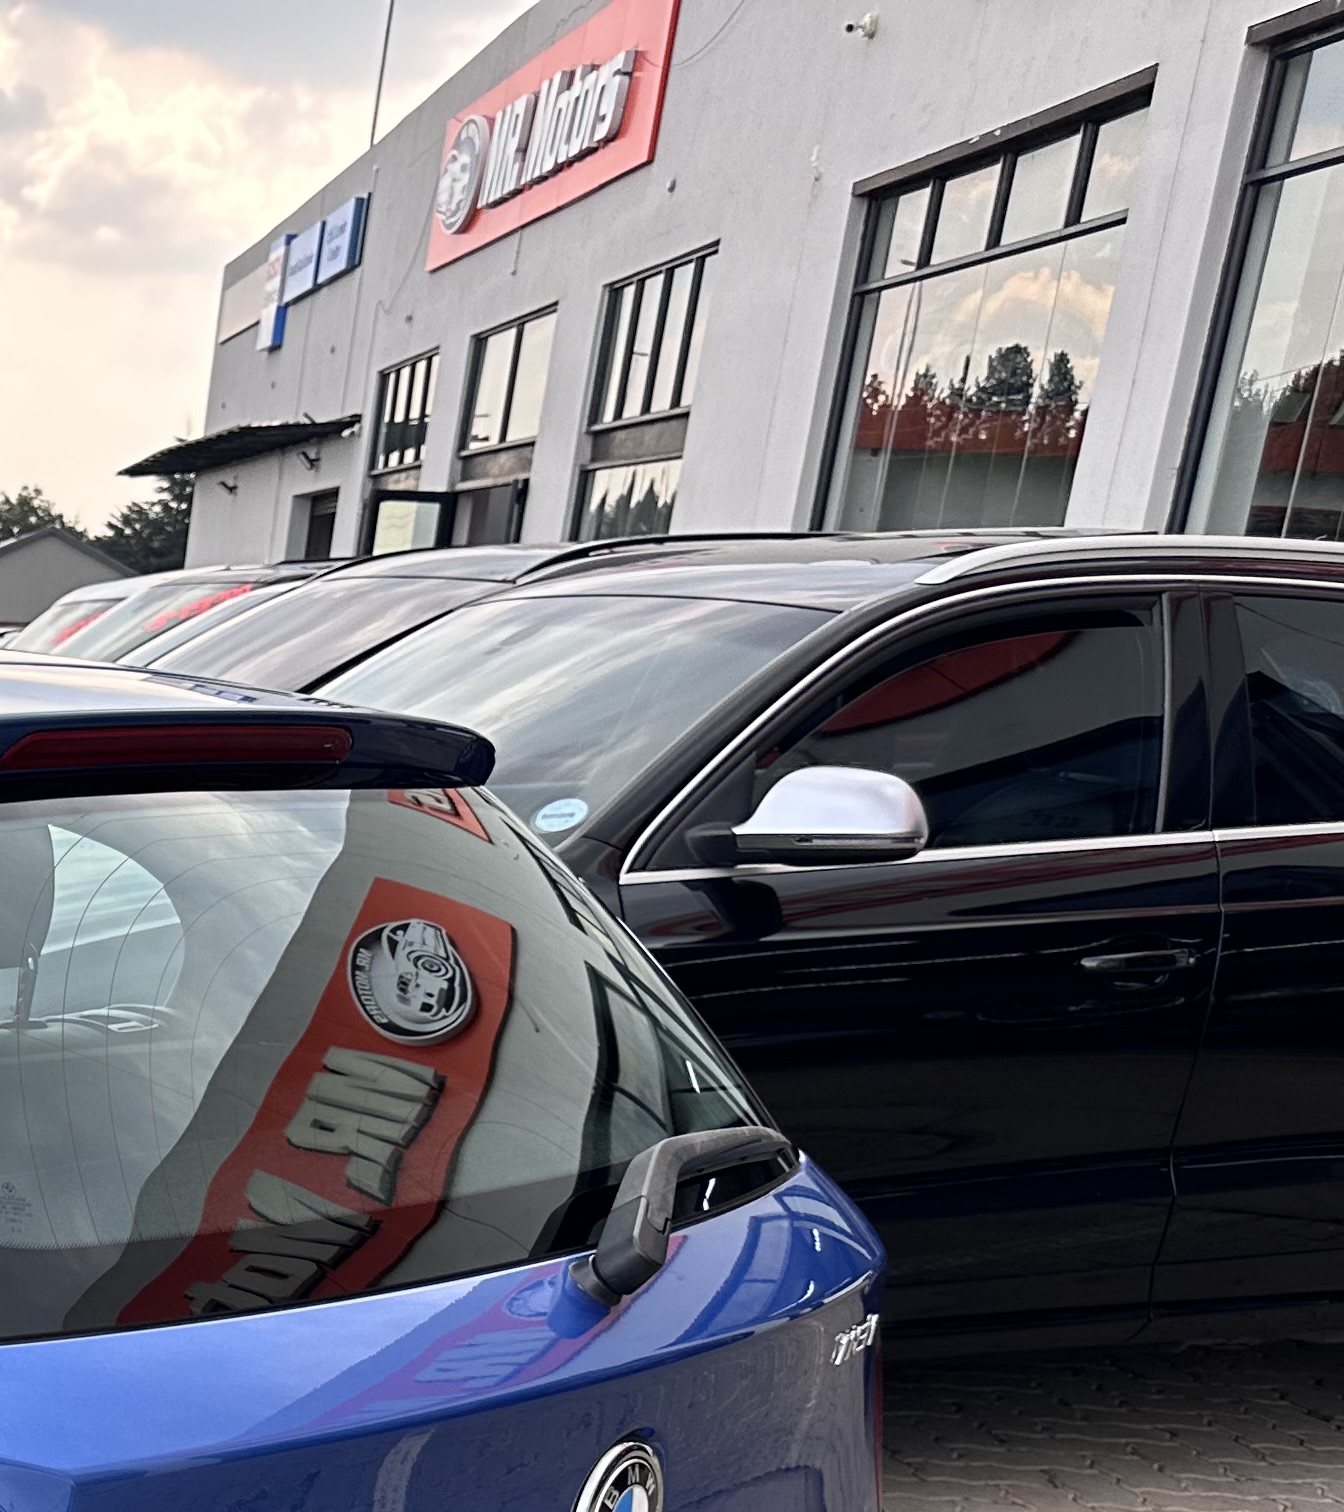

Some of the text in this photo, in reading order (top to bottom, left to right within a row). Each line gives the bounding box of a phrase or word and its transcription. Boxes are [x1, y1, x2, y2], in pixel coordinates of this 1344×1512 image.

[476, 47, 636, 209] MR. Motors
[602, 1463, 656, 1510] BMW
